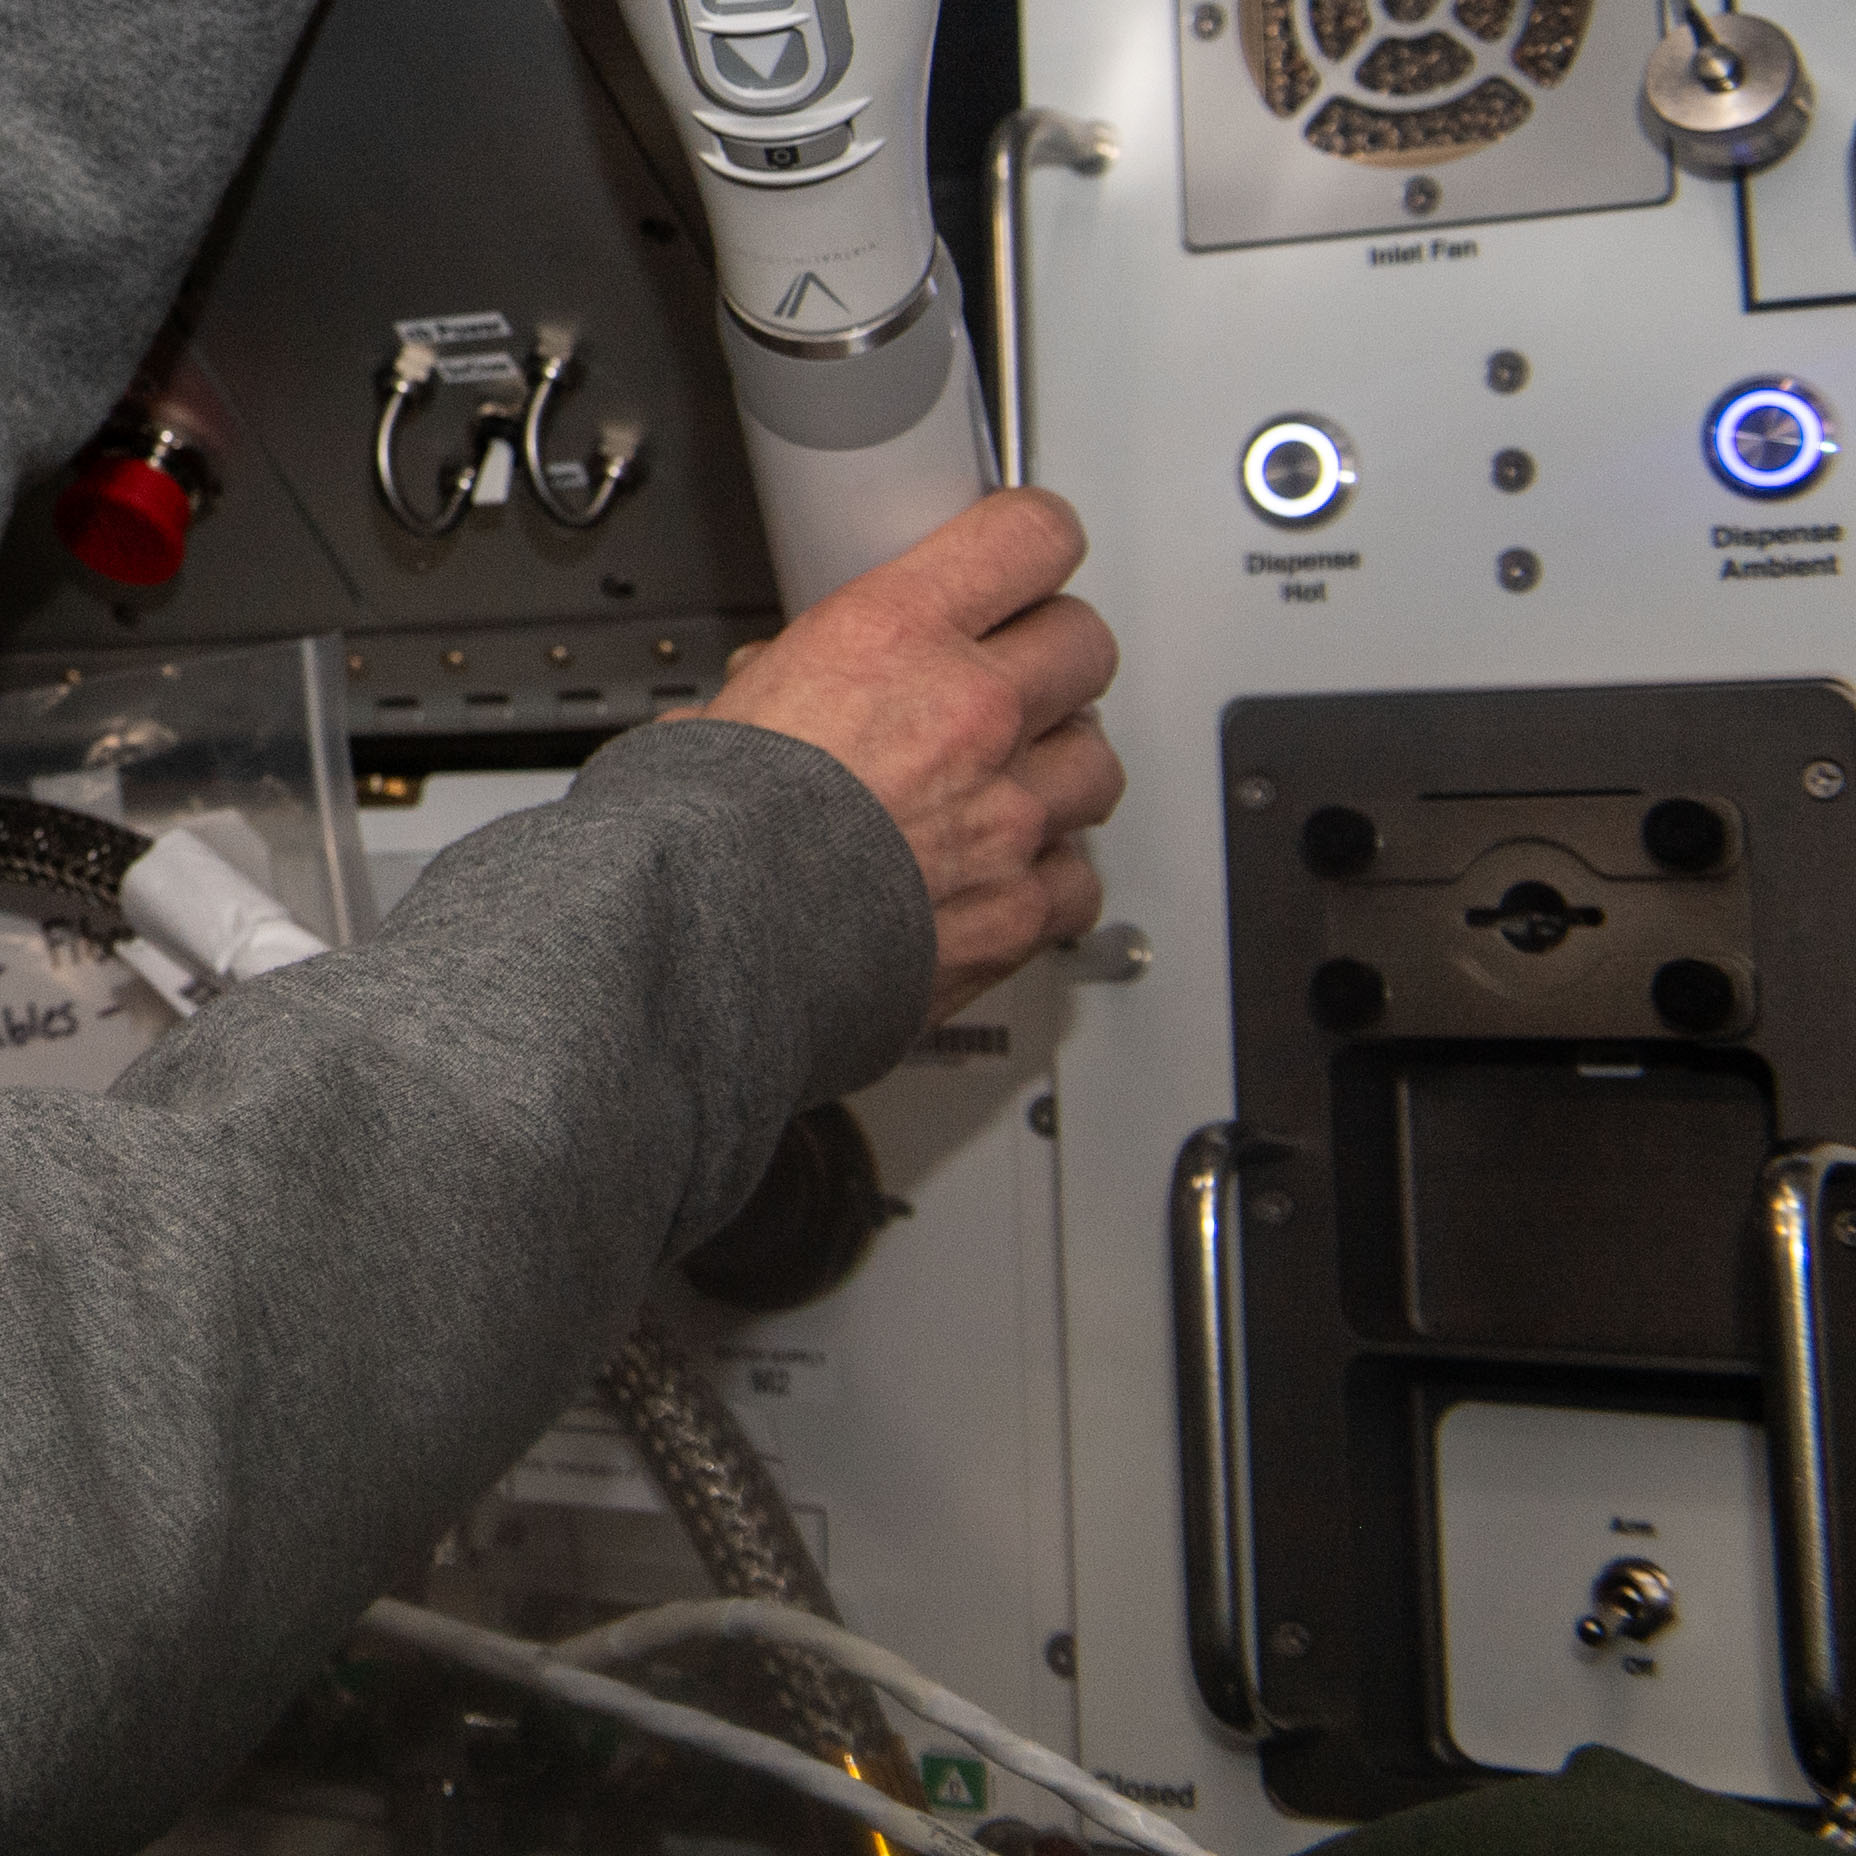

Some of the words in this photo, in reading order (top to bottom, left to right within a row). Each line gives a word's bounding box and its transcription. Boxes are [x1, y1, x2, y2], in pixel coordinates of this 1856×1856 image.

[1369, 245, 1422, 268] Inlet
[1431, 239, 1479, 262] Fan
[1712, 523, 1844, 550] Dispense
[1245, 550, 1362, 576] Dispense
[1721, 555, 1839, 582] Ambient
[1280, 580, 1327, 604] Hot
